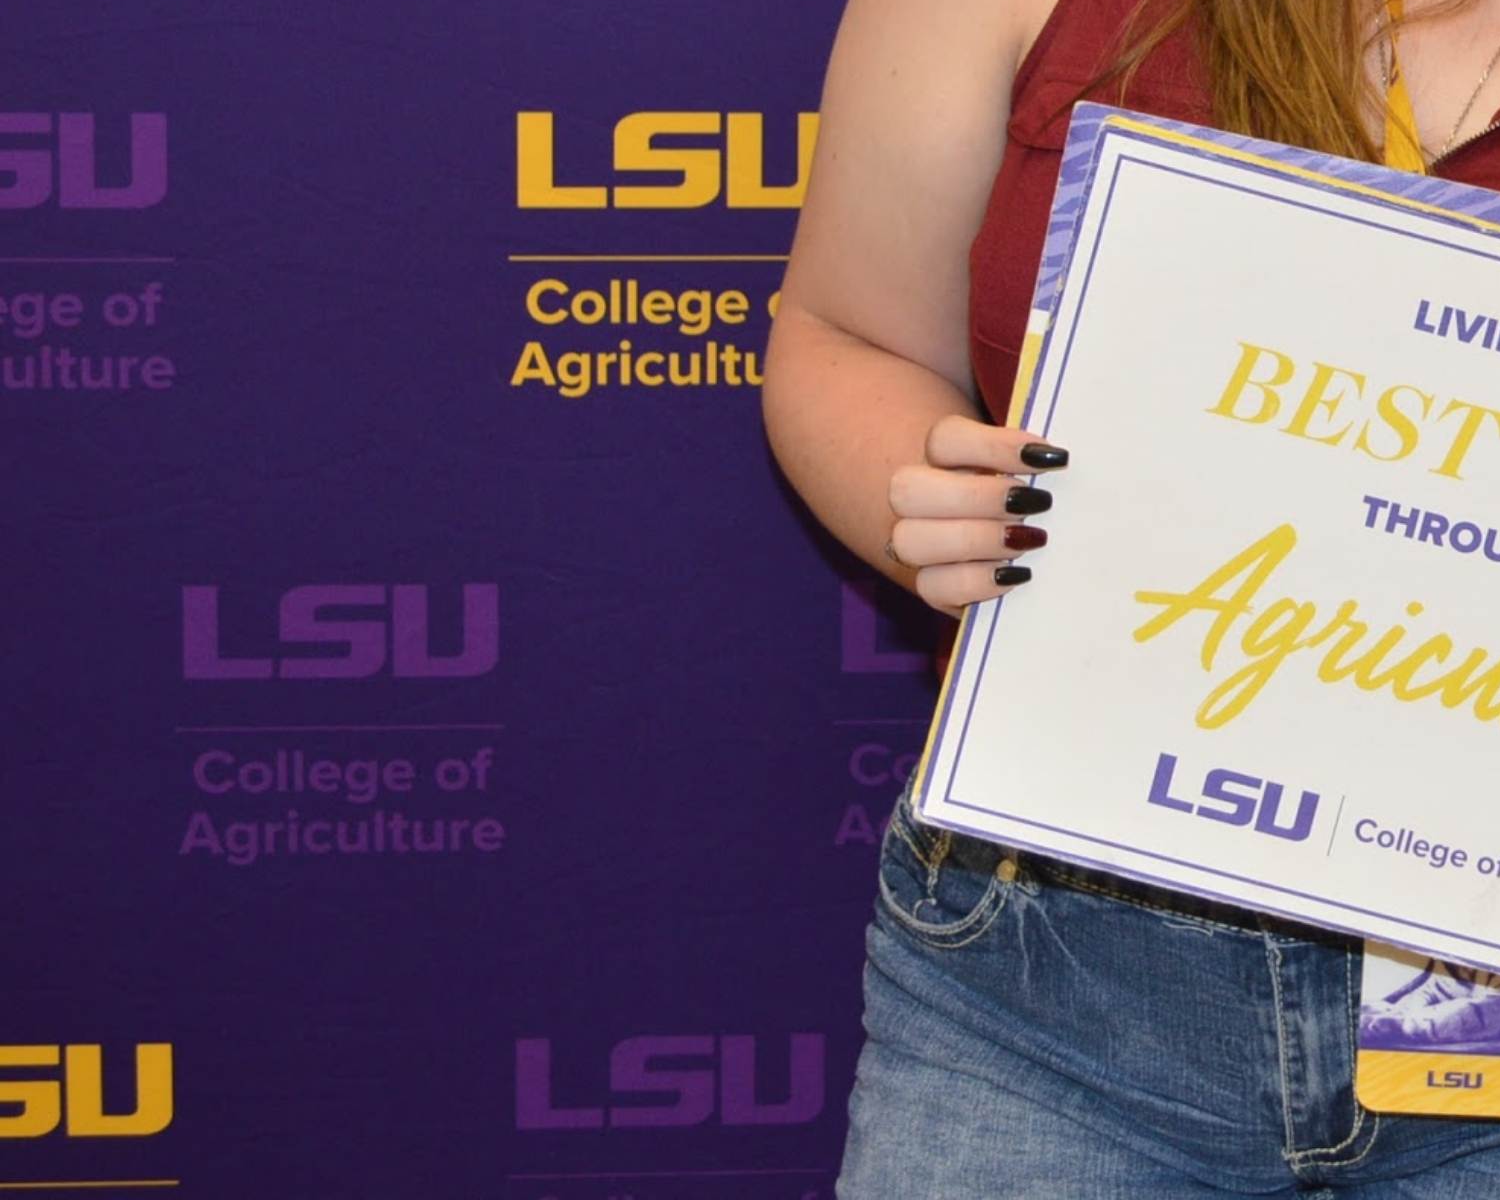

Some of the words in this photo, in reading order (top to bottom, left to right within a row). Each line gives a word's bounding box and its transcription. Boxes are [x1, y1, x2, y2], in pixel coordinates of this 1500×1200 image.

[103, 282, 163, 327] of
[525, 278, 749, 336] College
[2, 344, 176, 390] ulture
[182, 582, 500, 680] LSU
[192, 749, 415, 804] College
[435, 746, 494, 791] of
[1147, 752, 1321, 843] LSU
[179, 809, 506, 866] Agriculture
[1353, 817, 1469, 873] College
[515, 1032, 825, 1130] LSU
[1427, 1070, 1483, 1089] LSU
